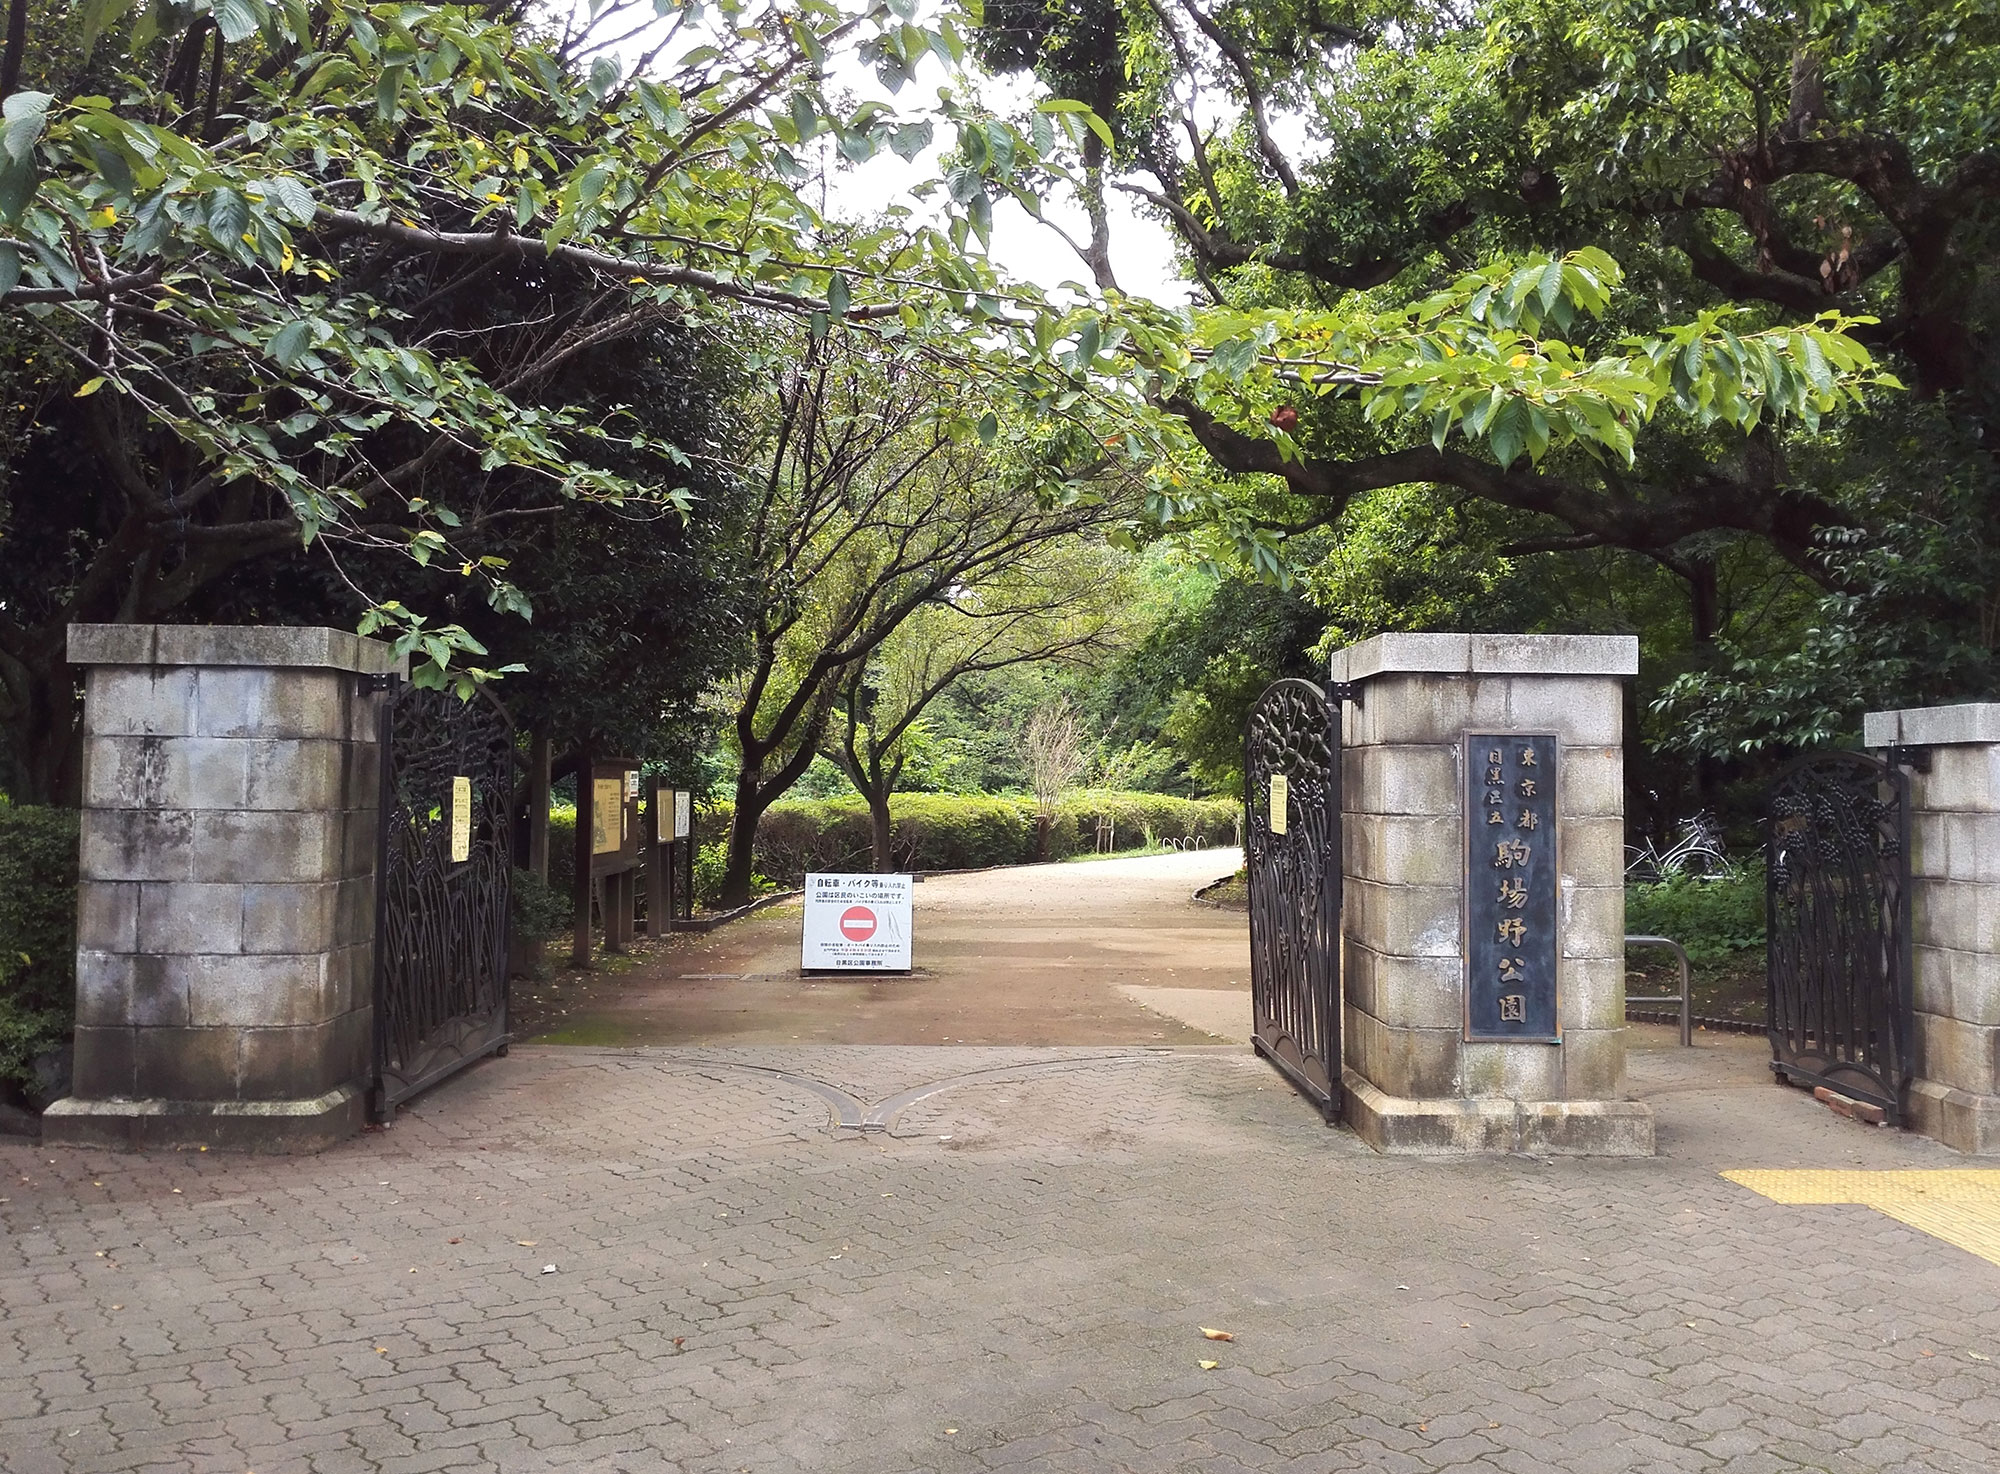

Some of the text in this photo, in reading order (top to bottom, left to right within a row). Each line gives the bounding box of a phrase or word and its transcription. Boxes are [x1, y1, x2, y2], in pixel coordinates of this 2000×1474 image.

[1486, 747, 1505, 825] 目黒区立
[1517, 746, 1539, 831] 東京都
[1493, 838, 1532, 1023] 駒場野公園
